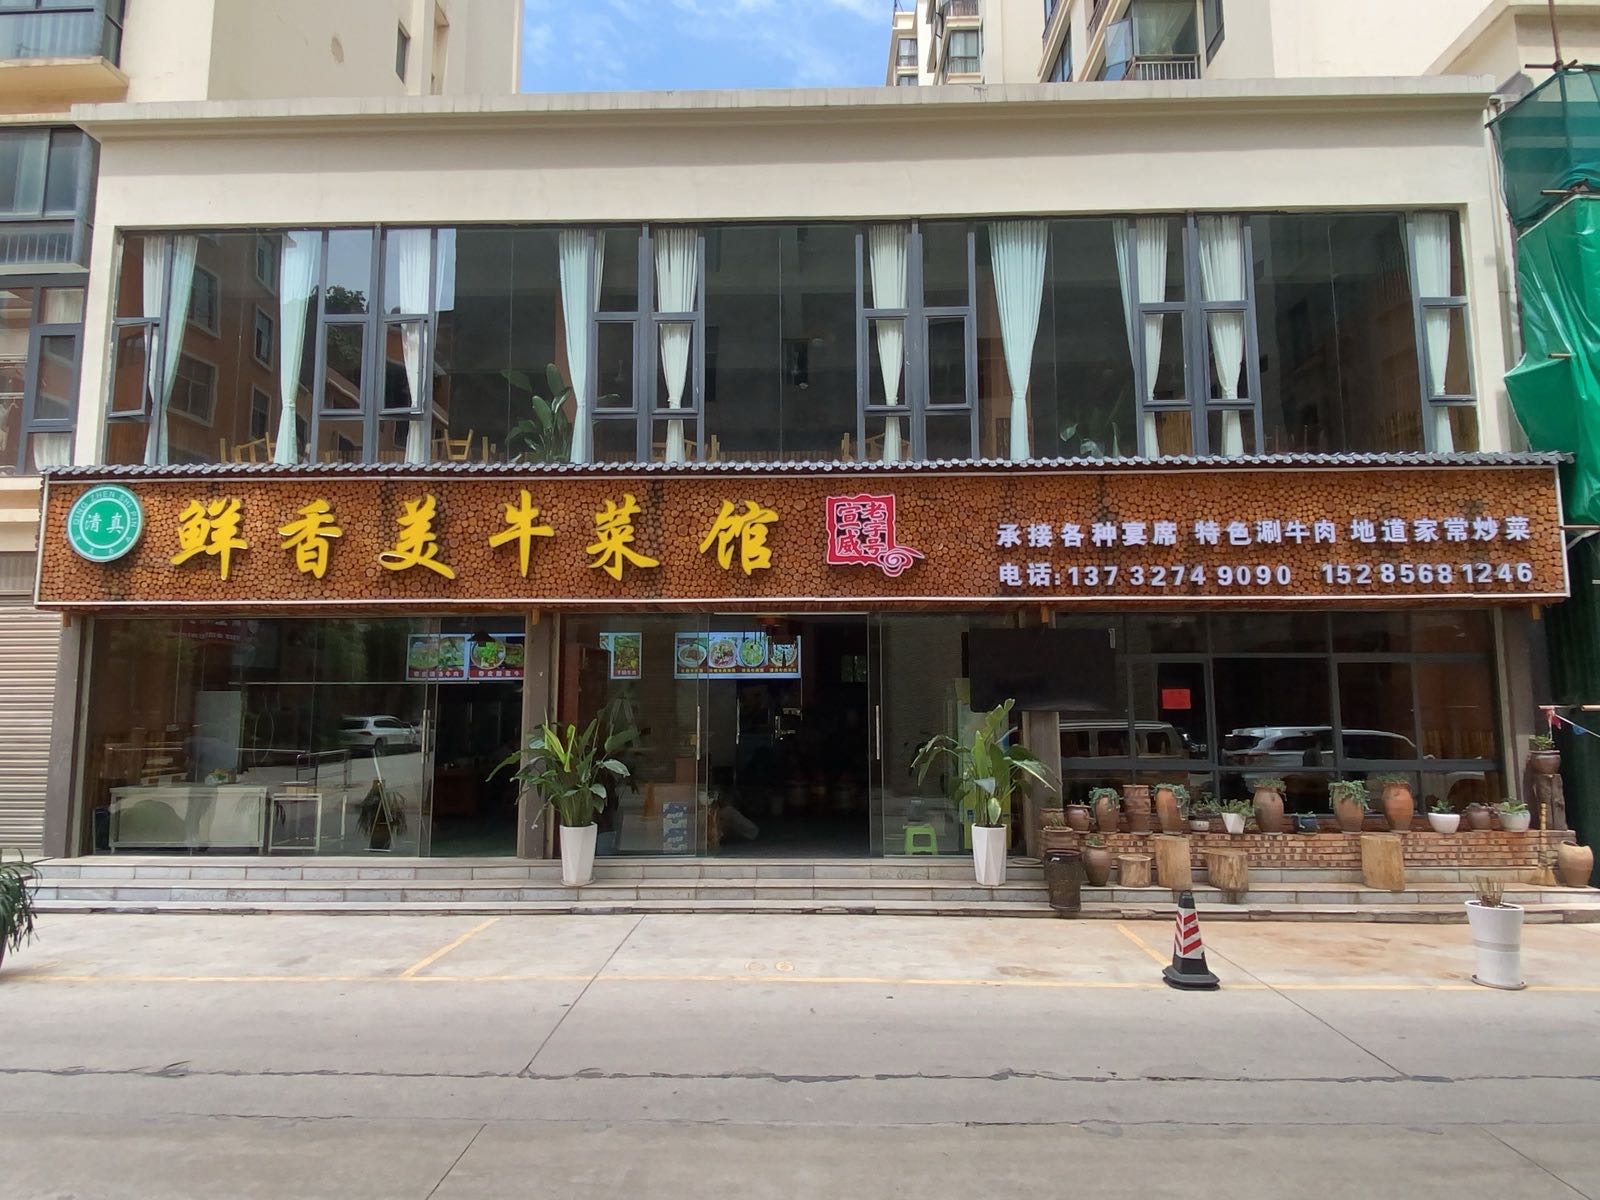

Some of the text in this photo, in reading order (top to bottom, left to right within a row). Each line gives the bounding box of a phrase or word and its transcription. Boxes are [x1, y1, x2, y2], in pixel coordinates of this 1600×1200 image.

[84, 512, 125, 534] 清真
[171, 490, 778, 579] 鲜香美牛菜馆
[836, 503, 862, 556] 宣威
[861, 501, 888, 557] 老字号
[997, 516, 1532, 548] 承接各种宴席 特色涮牛肉 地道家常炒菜
